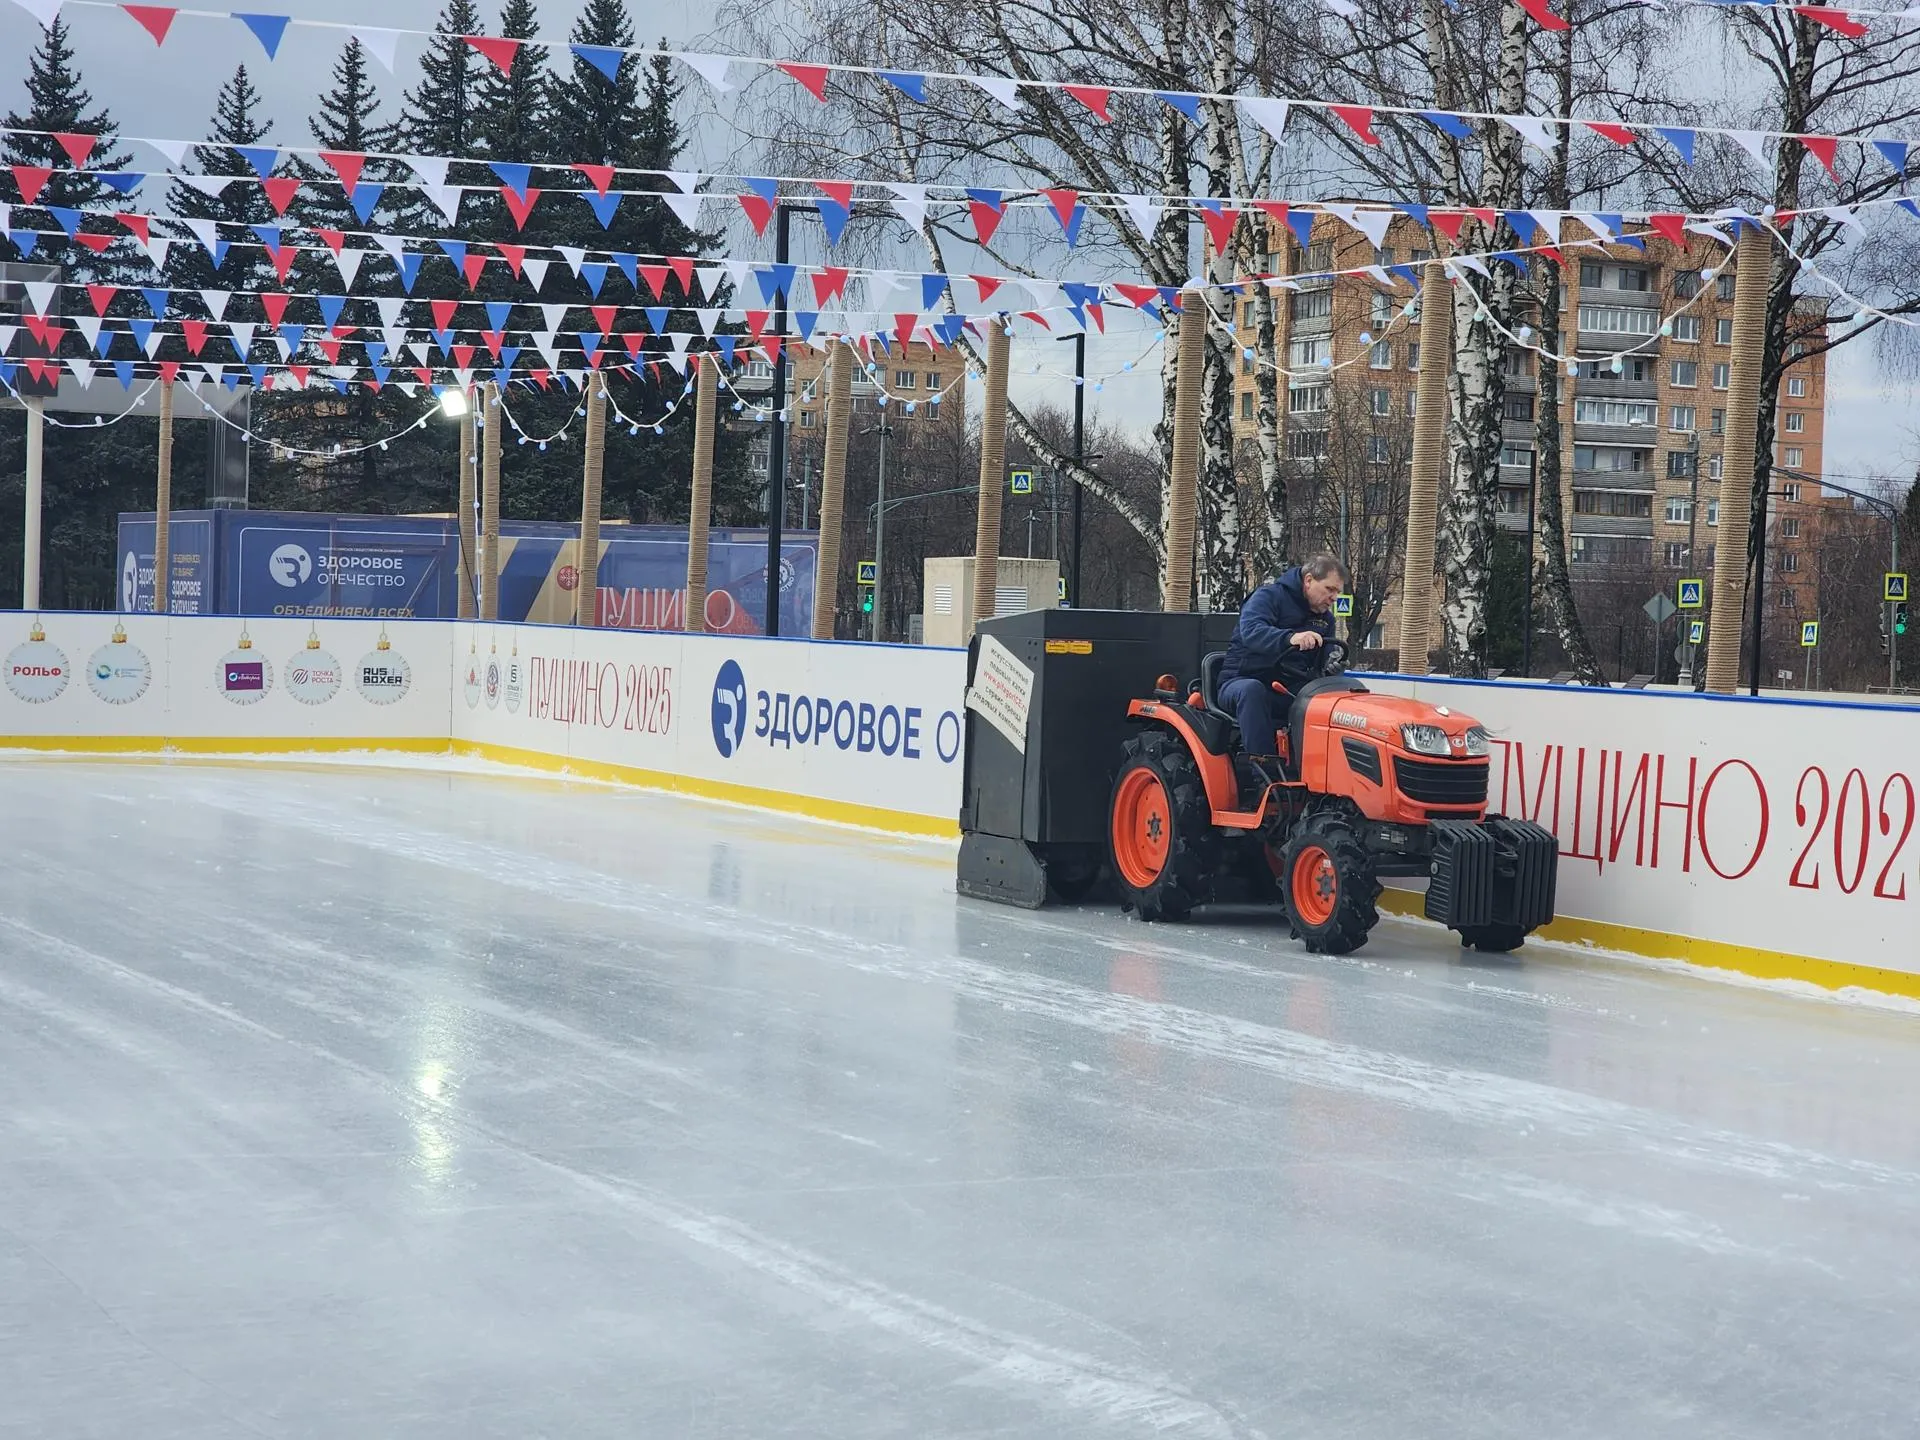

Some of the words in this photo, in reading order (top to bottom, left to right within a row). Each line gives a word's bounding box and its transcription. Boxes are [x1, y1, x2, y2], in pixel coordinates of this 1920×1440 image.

[317, 555, 403, 570] ЗДОРОВОЕ
[317, 573, 405, 587] ОТЕЧЕСТВО
[273, 604, 375, 617] ОБЪЕДИНЯЕМ
[13, 666, 62, 676] РОЛЬФ
[363, 667, 388, 675] RUS
[363, 675, 403, 684] BOXER
[529, 656, 620, 729] ПУЩИНО
[623, 663, 672, 735] 2025
[755, 690, 922, 760] ЗДОРОВОЕ
[936, 710, 966, 763] О
[1332, 711, 1367, 729] KUBOTA
[1788, 765, 1920, 901] 202
